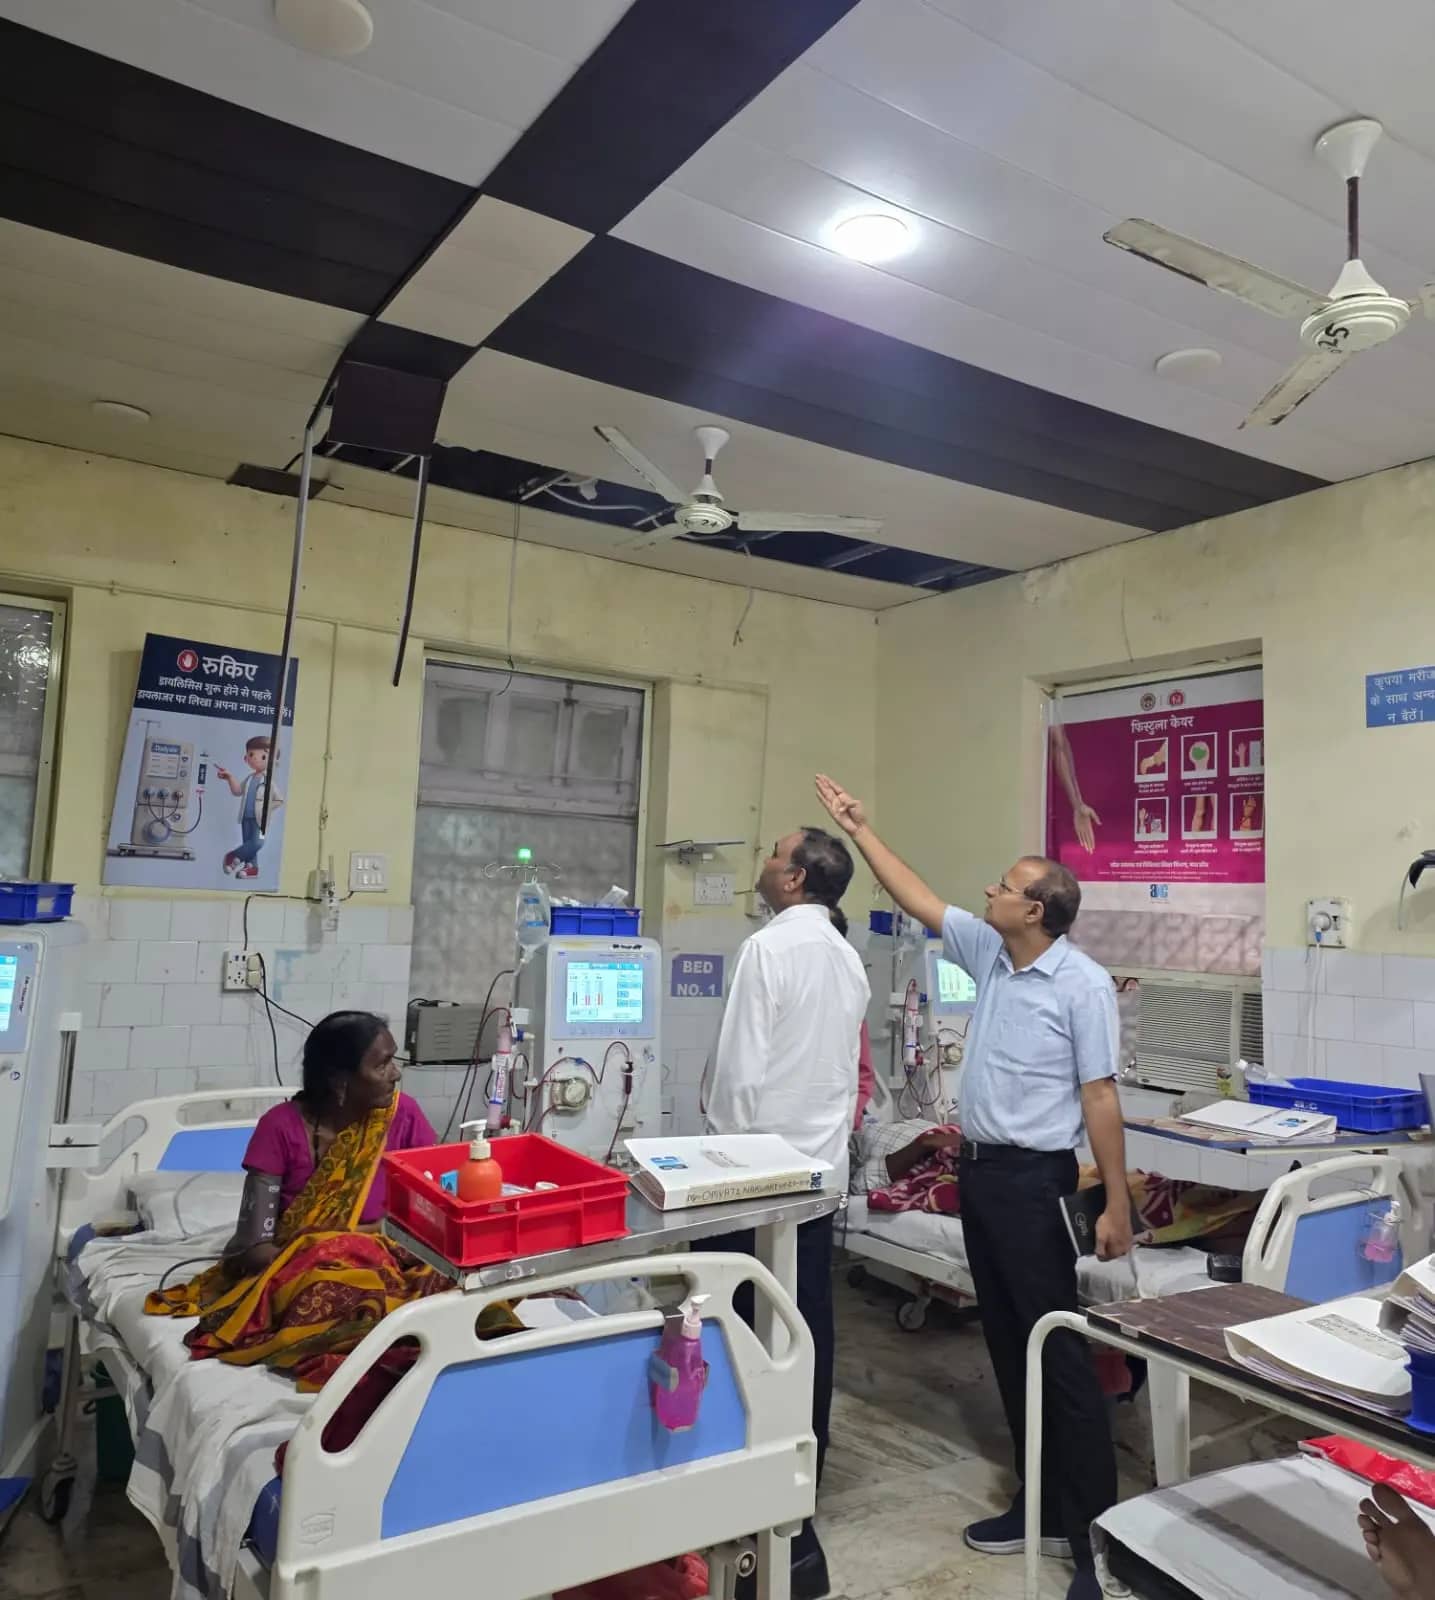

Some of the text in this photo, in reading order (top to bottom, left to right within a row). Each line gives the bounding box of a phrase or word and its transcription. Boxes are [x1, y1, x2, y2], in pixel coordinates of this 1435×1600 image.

[202, 654, 258, 681] रुकिए
[158, 676, 203, 691] डायलिसिस
[223, 684, 240, 697] होने
[241, 686, 250, 698] से
[251, 689, 273, 701] पहले
[1374, 673, 1403, 690] कृपया
[175, 694, 187, 704] पर
[214, 699, 238, 711] अपना
[240, 703, 257, 713] नाम
[1169, 714, 1195, 728] केयर
[1386, 712, 1397, 724] न
[682, 960, 713, 974] BED
[677, 983, 716, 996] NO. 1
